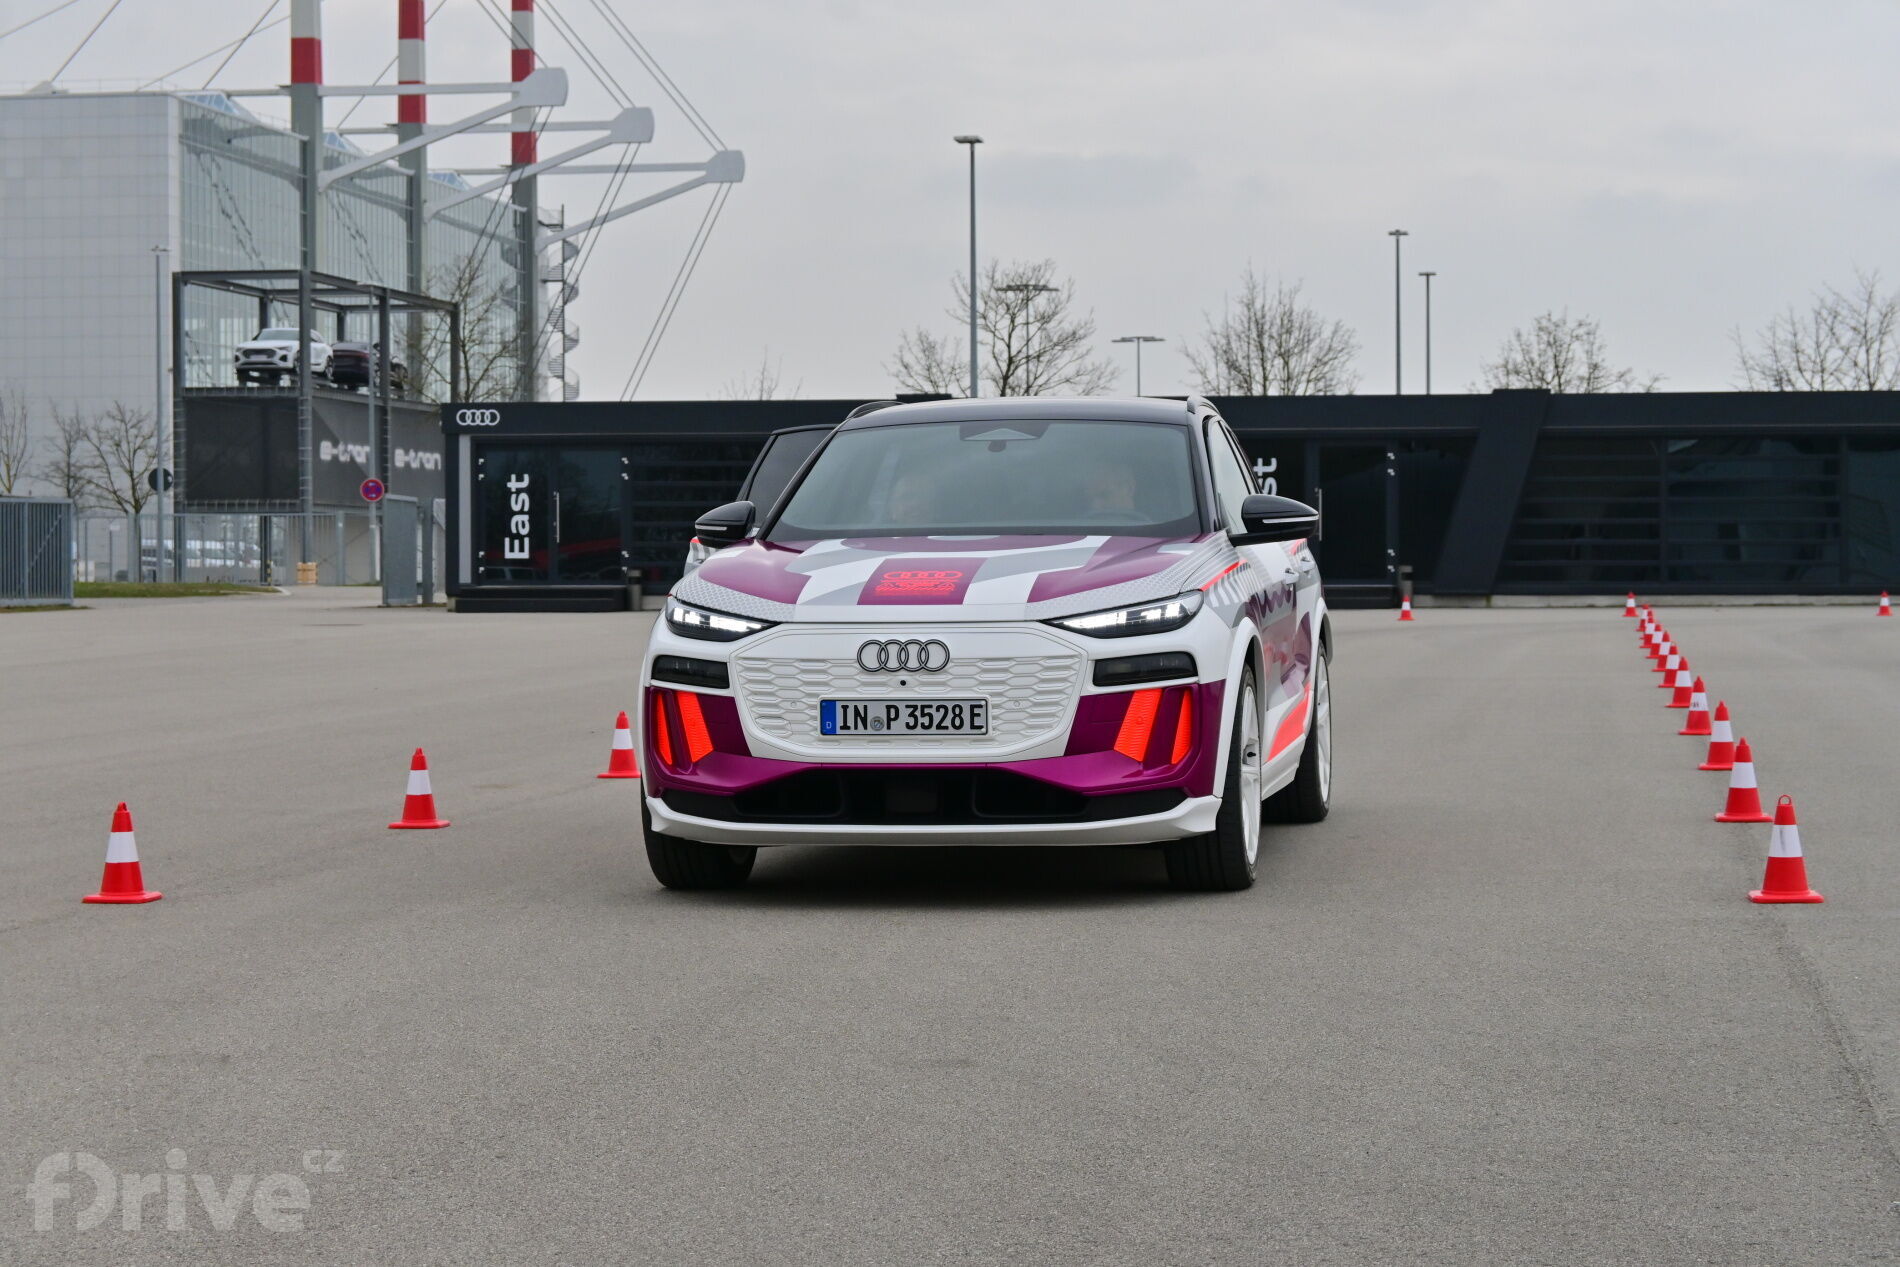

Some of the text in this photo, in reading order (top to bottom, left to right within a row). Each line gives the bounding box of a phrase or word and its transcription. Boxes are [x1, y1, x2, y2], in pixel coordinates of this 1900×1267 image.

[394, 448, 442, 470] e-tron
[1253, 457, 1278, 496] st
[504, 473, 530, 559] East
[840, 704, 868, 730] IN
